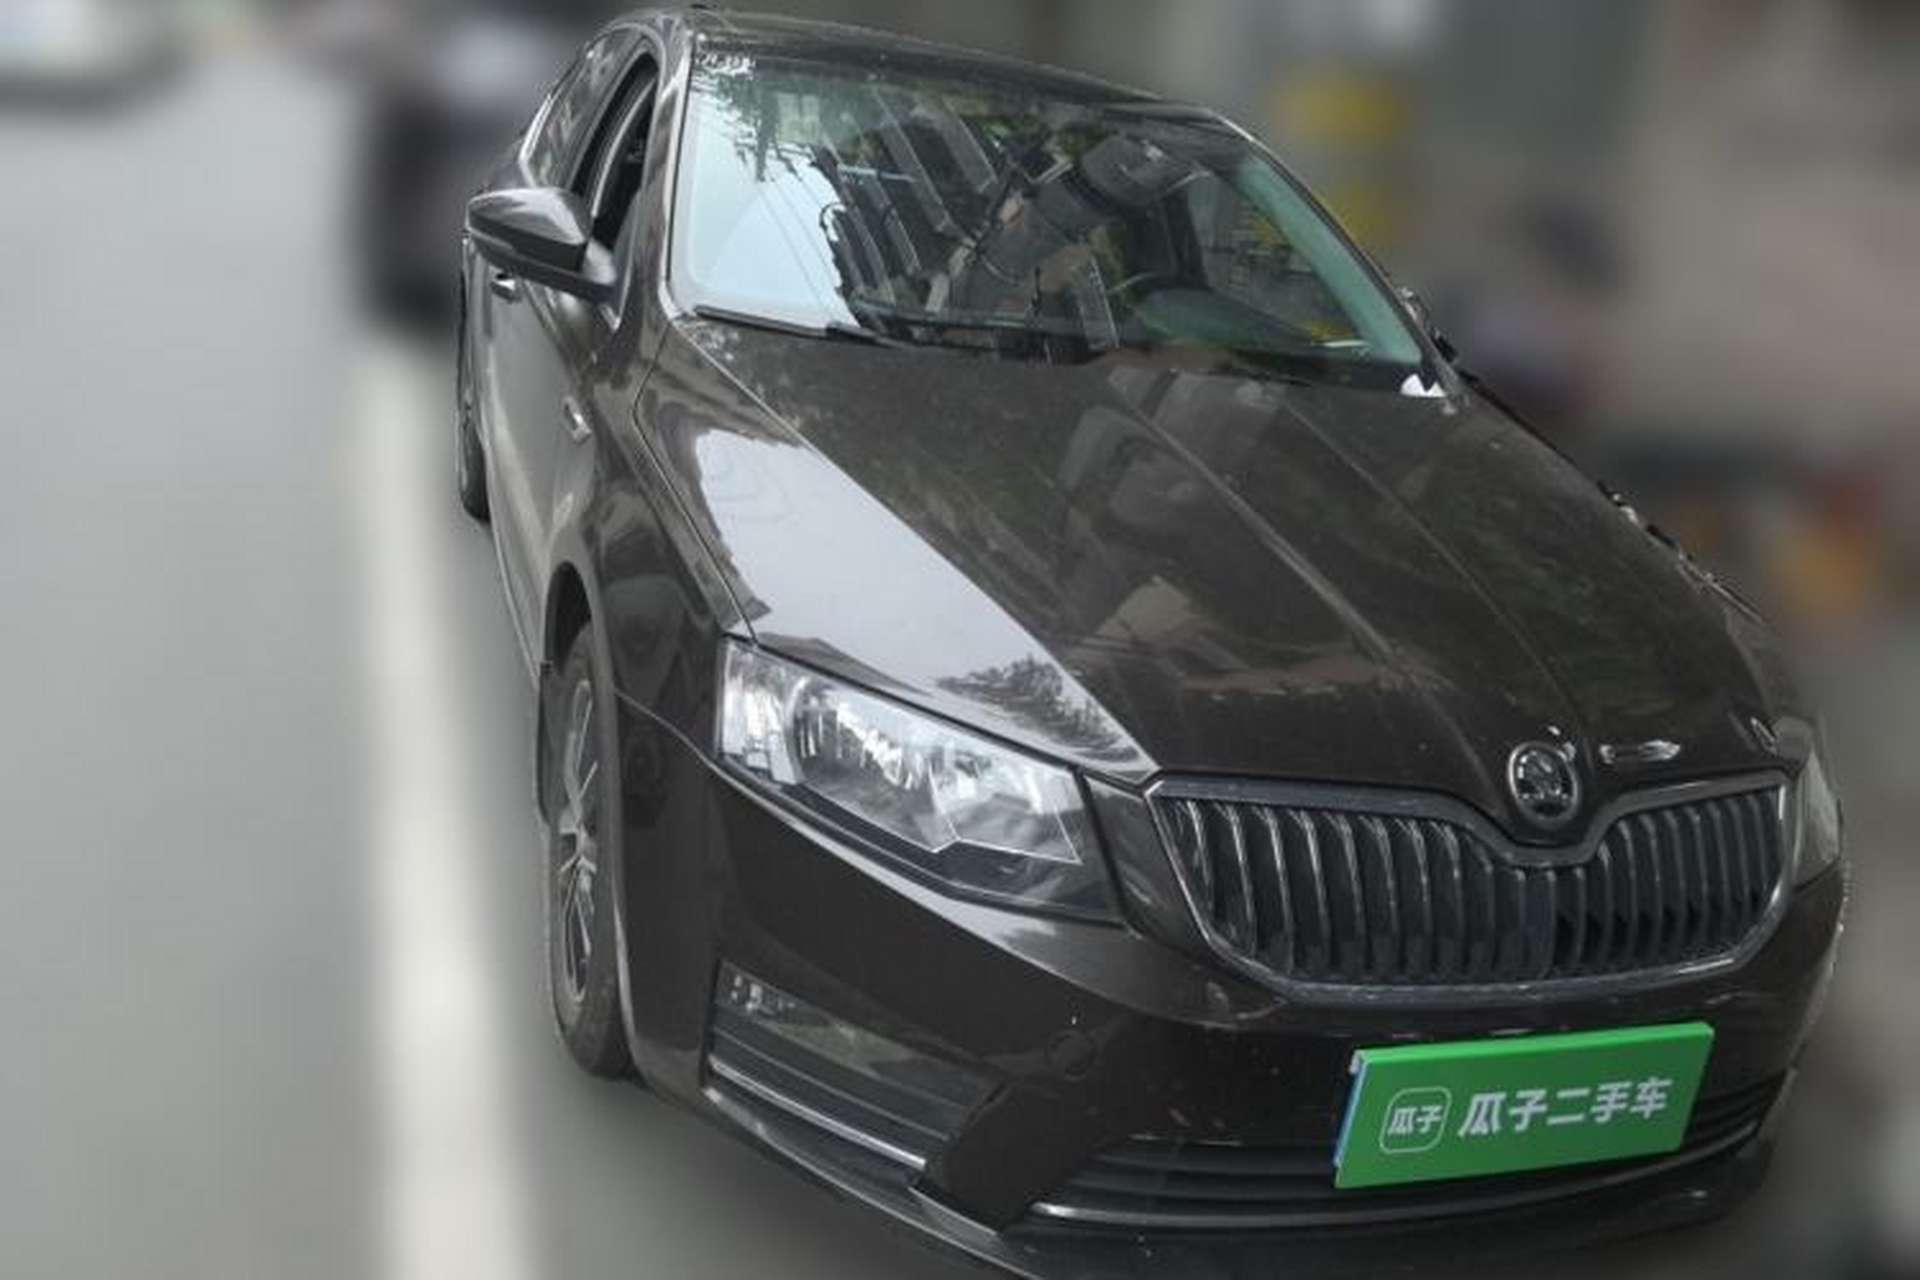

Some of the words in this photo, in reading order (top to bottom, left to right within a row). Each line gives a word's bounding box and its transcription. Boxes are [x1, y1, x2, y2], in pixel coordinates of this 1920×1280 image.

[1388, 1104, 1442, 1136] 瓜子
[1459, 1077, 1672, 1137] 瓜子二手车
